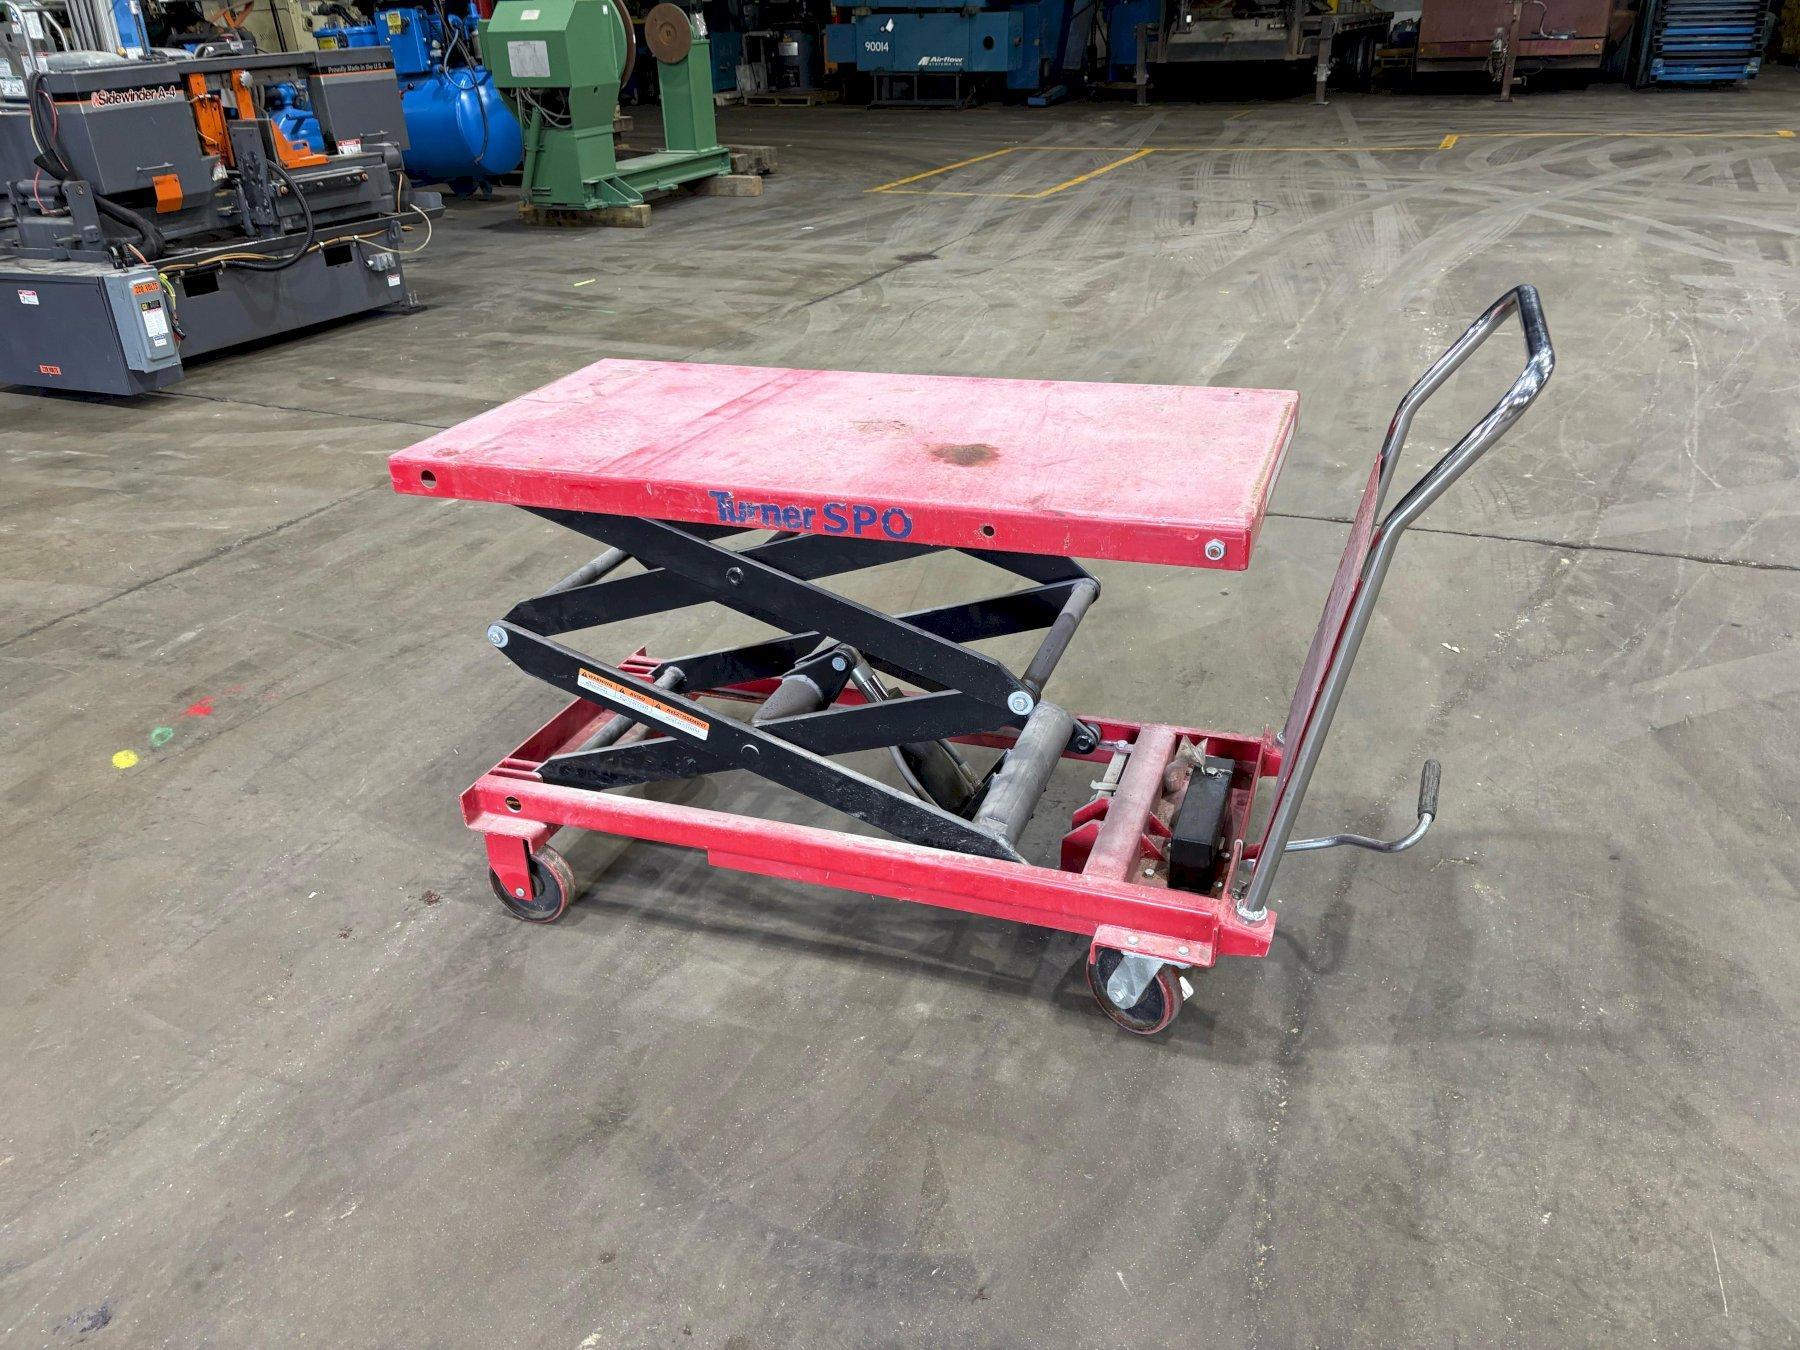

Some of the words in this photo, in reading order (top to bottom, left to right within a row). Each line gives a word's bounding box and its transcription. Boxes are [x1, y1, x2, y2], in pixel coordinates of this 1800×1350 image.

[865, 41, 889, 52] 90014
[98, 87, 157, 106] Sidewinder
[158, 85, 176, 99] A-4
[709, 490, 816, 530] Turner
[823, 502, 913, 540] SPO
[588, 673, 613, 688] WARNING
[629, 691, 646, 702] AVISO
